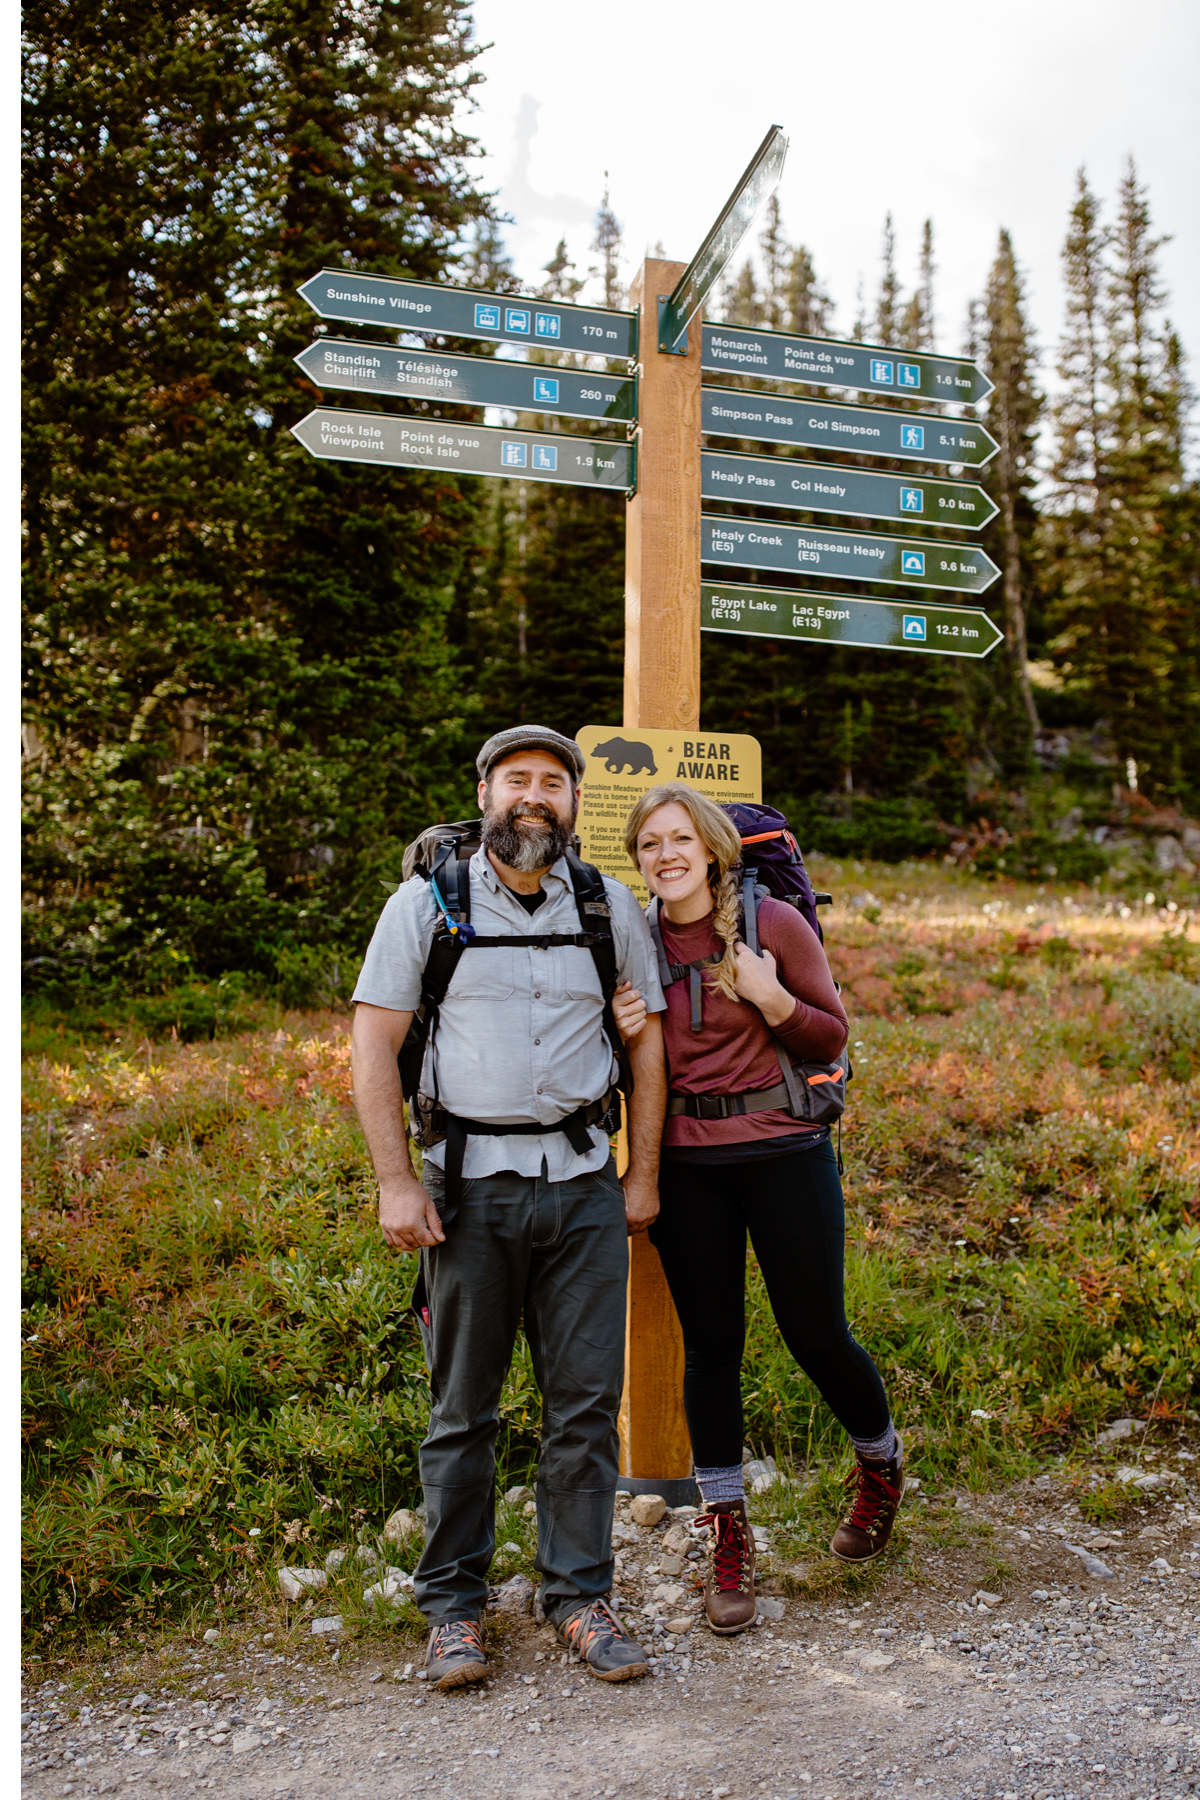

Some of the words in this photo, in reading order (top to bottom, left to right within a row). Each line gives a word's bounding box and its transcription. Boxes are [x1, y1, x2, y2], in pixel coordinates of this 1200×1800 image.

[327, 288, 385, 306] Sunshine
[390, 297, 432, 313] Village
[582, 326, 603, 337] 170
[607, 330, 618, 339] m
[712, 336, 762, 352] Monarch
[324, 351, 380, 367] Standish
[712, 348, 768, 365] Viewpoint
[785, 347, 814, 360] Point
[818, 351, 831, 362] de
[835, 356, 855, 366] vue
[324, 364, 377, 379] Chairlift
[398, 360, 458, 377] Télésiège
[785, 359, 834, 374] Monarch
[397, 372, 452, 388] Standish
[936, 375, 952, 385] 1.6
[955, 378, 972, 388] km
[580, 389, 602, 401] 260
[605, 393, 616, 402] m
[712, 406, 762, 422] Simpson
[766, 412, 793, 426] Pass
[321, 422, 354, 435] Rock
[358, 426, 382, 438] Isle
[809, 418, 828, 429] Col
[831, 421, 880, 437] Simpson
[321, 434, 385, 450] Viewpoint
[401, 431, 435, 444] Point
[438, 435, 454, 445] de
[458, 439, 480, 448] vue
[939, 435, 956, 446] 5.1
[959, 438, 976, 448] km
[401, 442, 433, 455] Rock
[436, 446, 460, 458] Isle
[576, 456, 594, 467] 1.9
[597, 458, 616, 469] km
[712, 470, 744, 485] Healy
[747, 474, 775, 487] Pass
[792, 480, 811, 491] Col
[814, 483, 846, 496] Healy
[939, 498, 955, 508] 9.0
[958, 500, 975, 511] km
[712, 529, 745, 543] Healy
[748, 533, 783, 546] Creek
[712, 541, 734, 554] (E5)
[798, 538, 850, 554] Ruisseau
[854, 545, 885, 560] Healy
[798, 550, 820, 564] (E5)
[940, 560, 956, 571] 9.6
[960, 564, 977, 574] km
[712, 596, 745, 611] Egypt
[749, 600, 777, 612] Lake
[793, 604, 814, 616] Lac
[817, 607, 850, 620] Egypt
[712, 608, 741, 621] (E13)
[792, 616, 822, 630] (E13)
[936, 624, 959, 636] 12.2
[962, 627, 979, 638] km
[684, 742, 730, 760] BEAR
[676, 762, 739, 781] AWARE
[590, 844, 611, 852] Report
